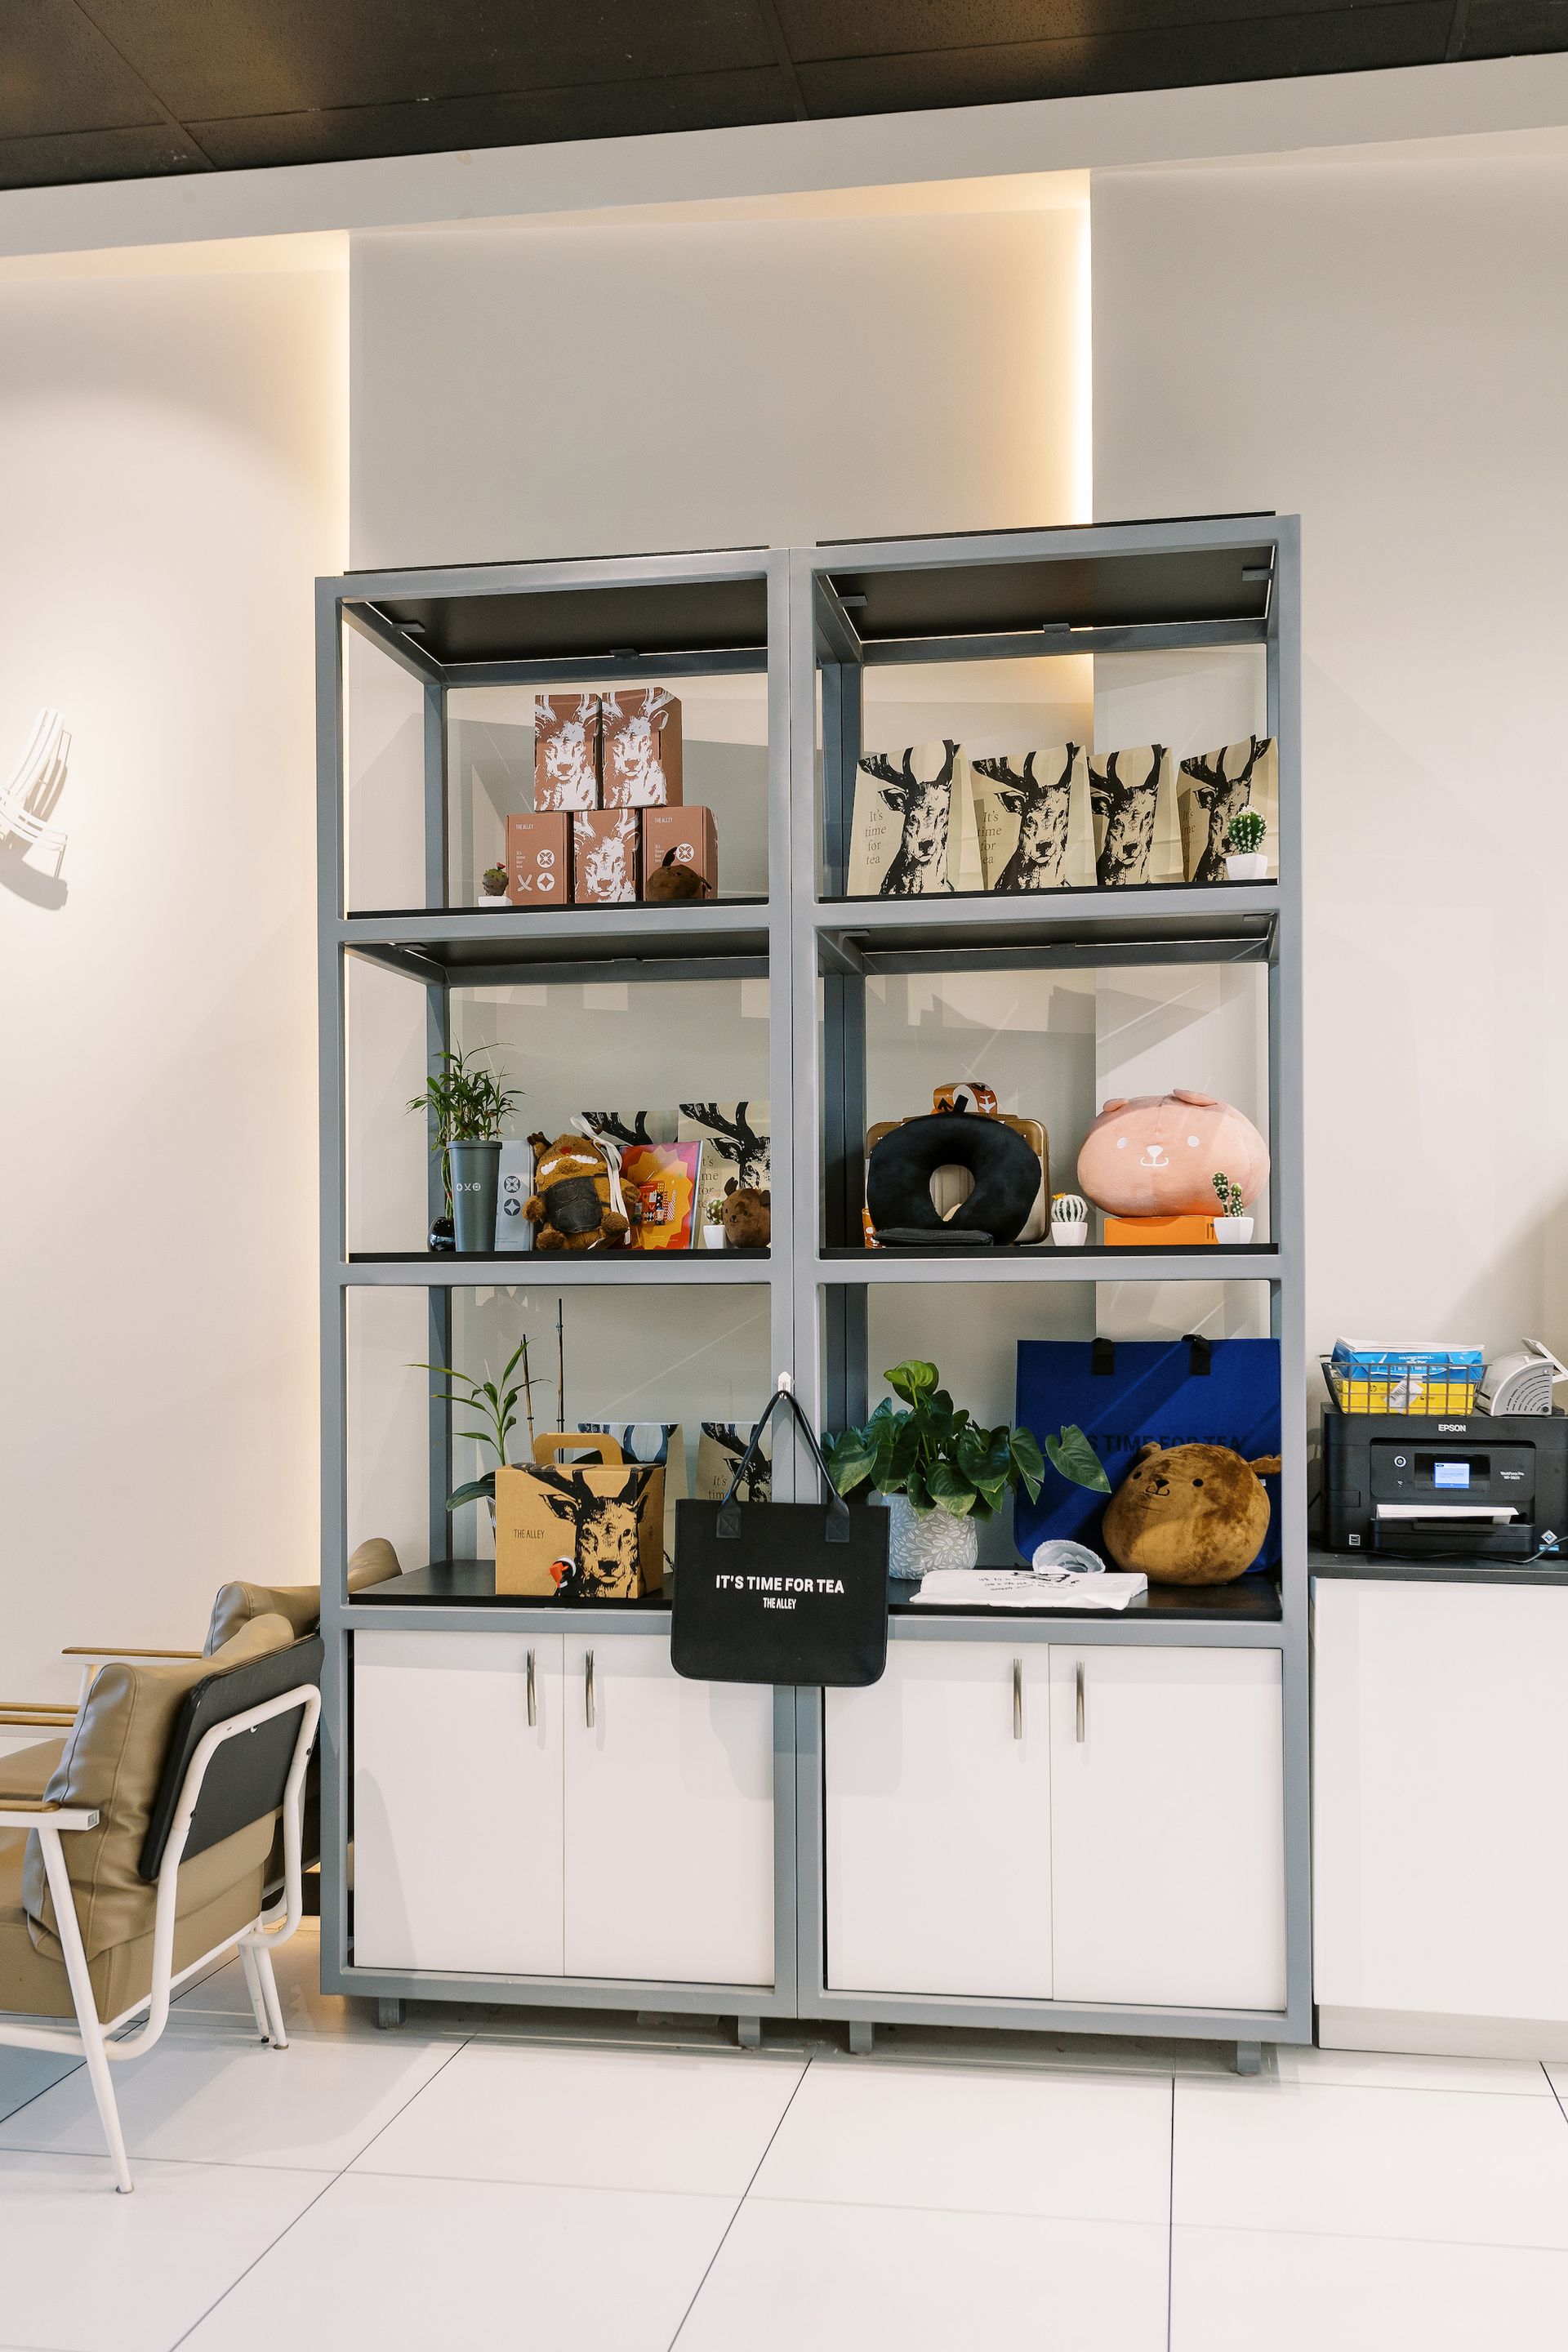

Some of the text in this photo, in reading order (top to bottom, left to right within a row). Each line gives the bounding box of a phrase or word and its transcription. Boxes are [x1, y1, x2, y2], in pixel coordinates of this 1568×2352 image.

[870, 808, 883, 822] It's
[982, 810, 999, 822] It's
[866, 826, 886, 837] time
[978, 826, 1002, 837] time
[1182, 824, 1196, 835] ime
[868, 840, 881, 851] for
[980, 840, 996, 851] for
[866, 855, 880, 865] tea
[702, 1155, 714, 1167] t's
[701, 1172, 719, 1181] me
[713, 1475, 727, 1486] It's
[709, 1490, 724, 1499] tim
[514, 1529, 545, 1539] THE ALLEY
[715, 1575, 845, 1593] IT'S TIME FOR TEA
[763, 1597, 797, 1610] THE ALLEY
